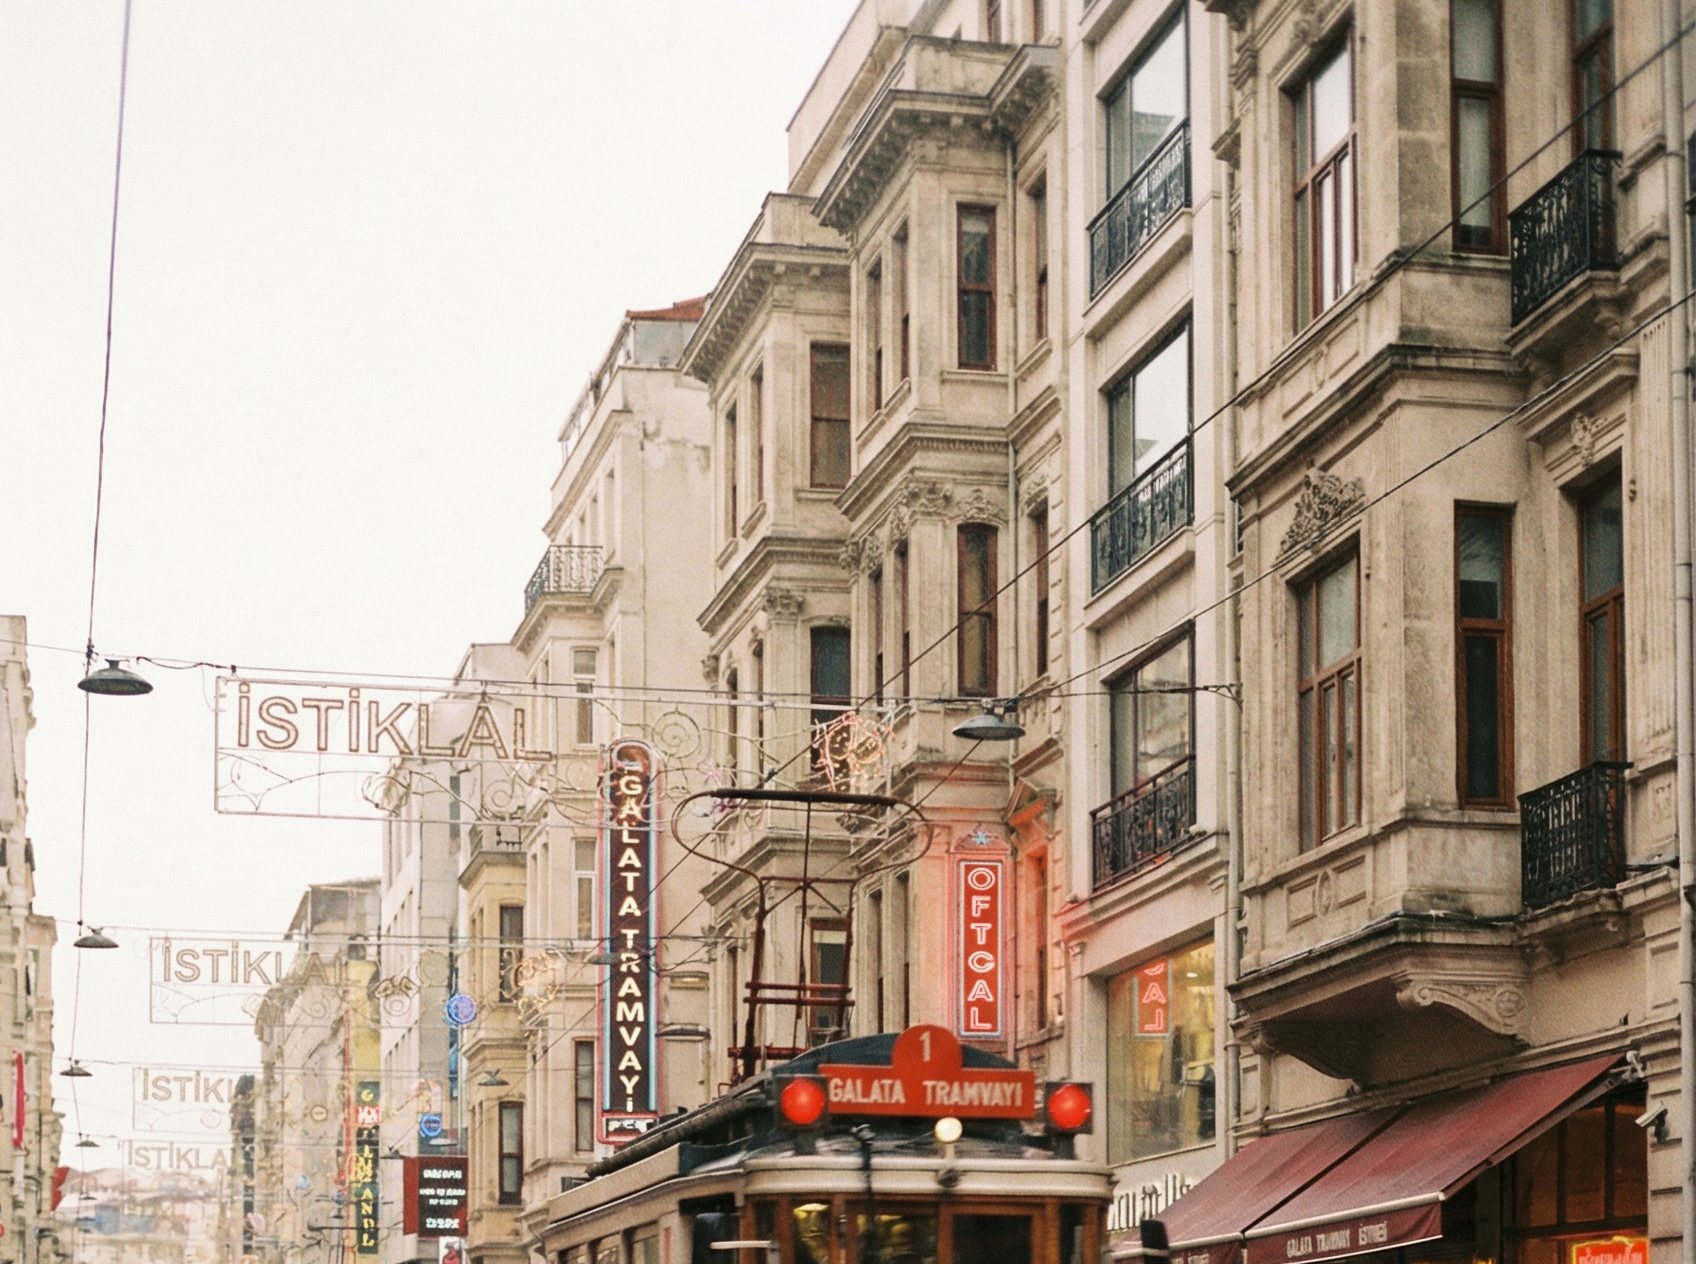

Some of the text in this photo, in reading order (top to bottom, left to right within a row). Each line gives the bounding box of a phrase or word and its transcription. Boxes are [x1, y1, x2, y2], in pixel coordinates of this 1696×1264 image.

[237, 681, 553, 762] İSTİKLAL
[618, 774, 643, 918] GALATA
[967, 867, 996, 1030] OFTCAL
[919, 1031, 931, 1062] 1
[828, 1077, 1023, 1107] GALATA TRAMVAYI
